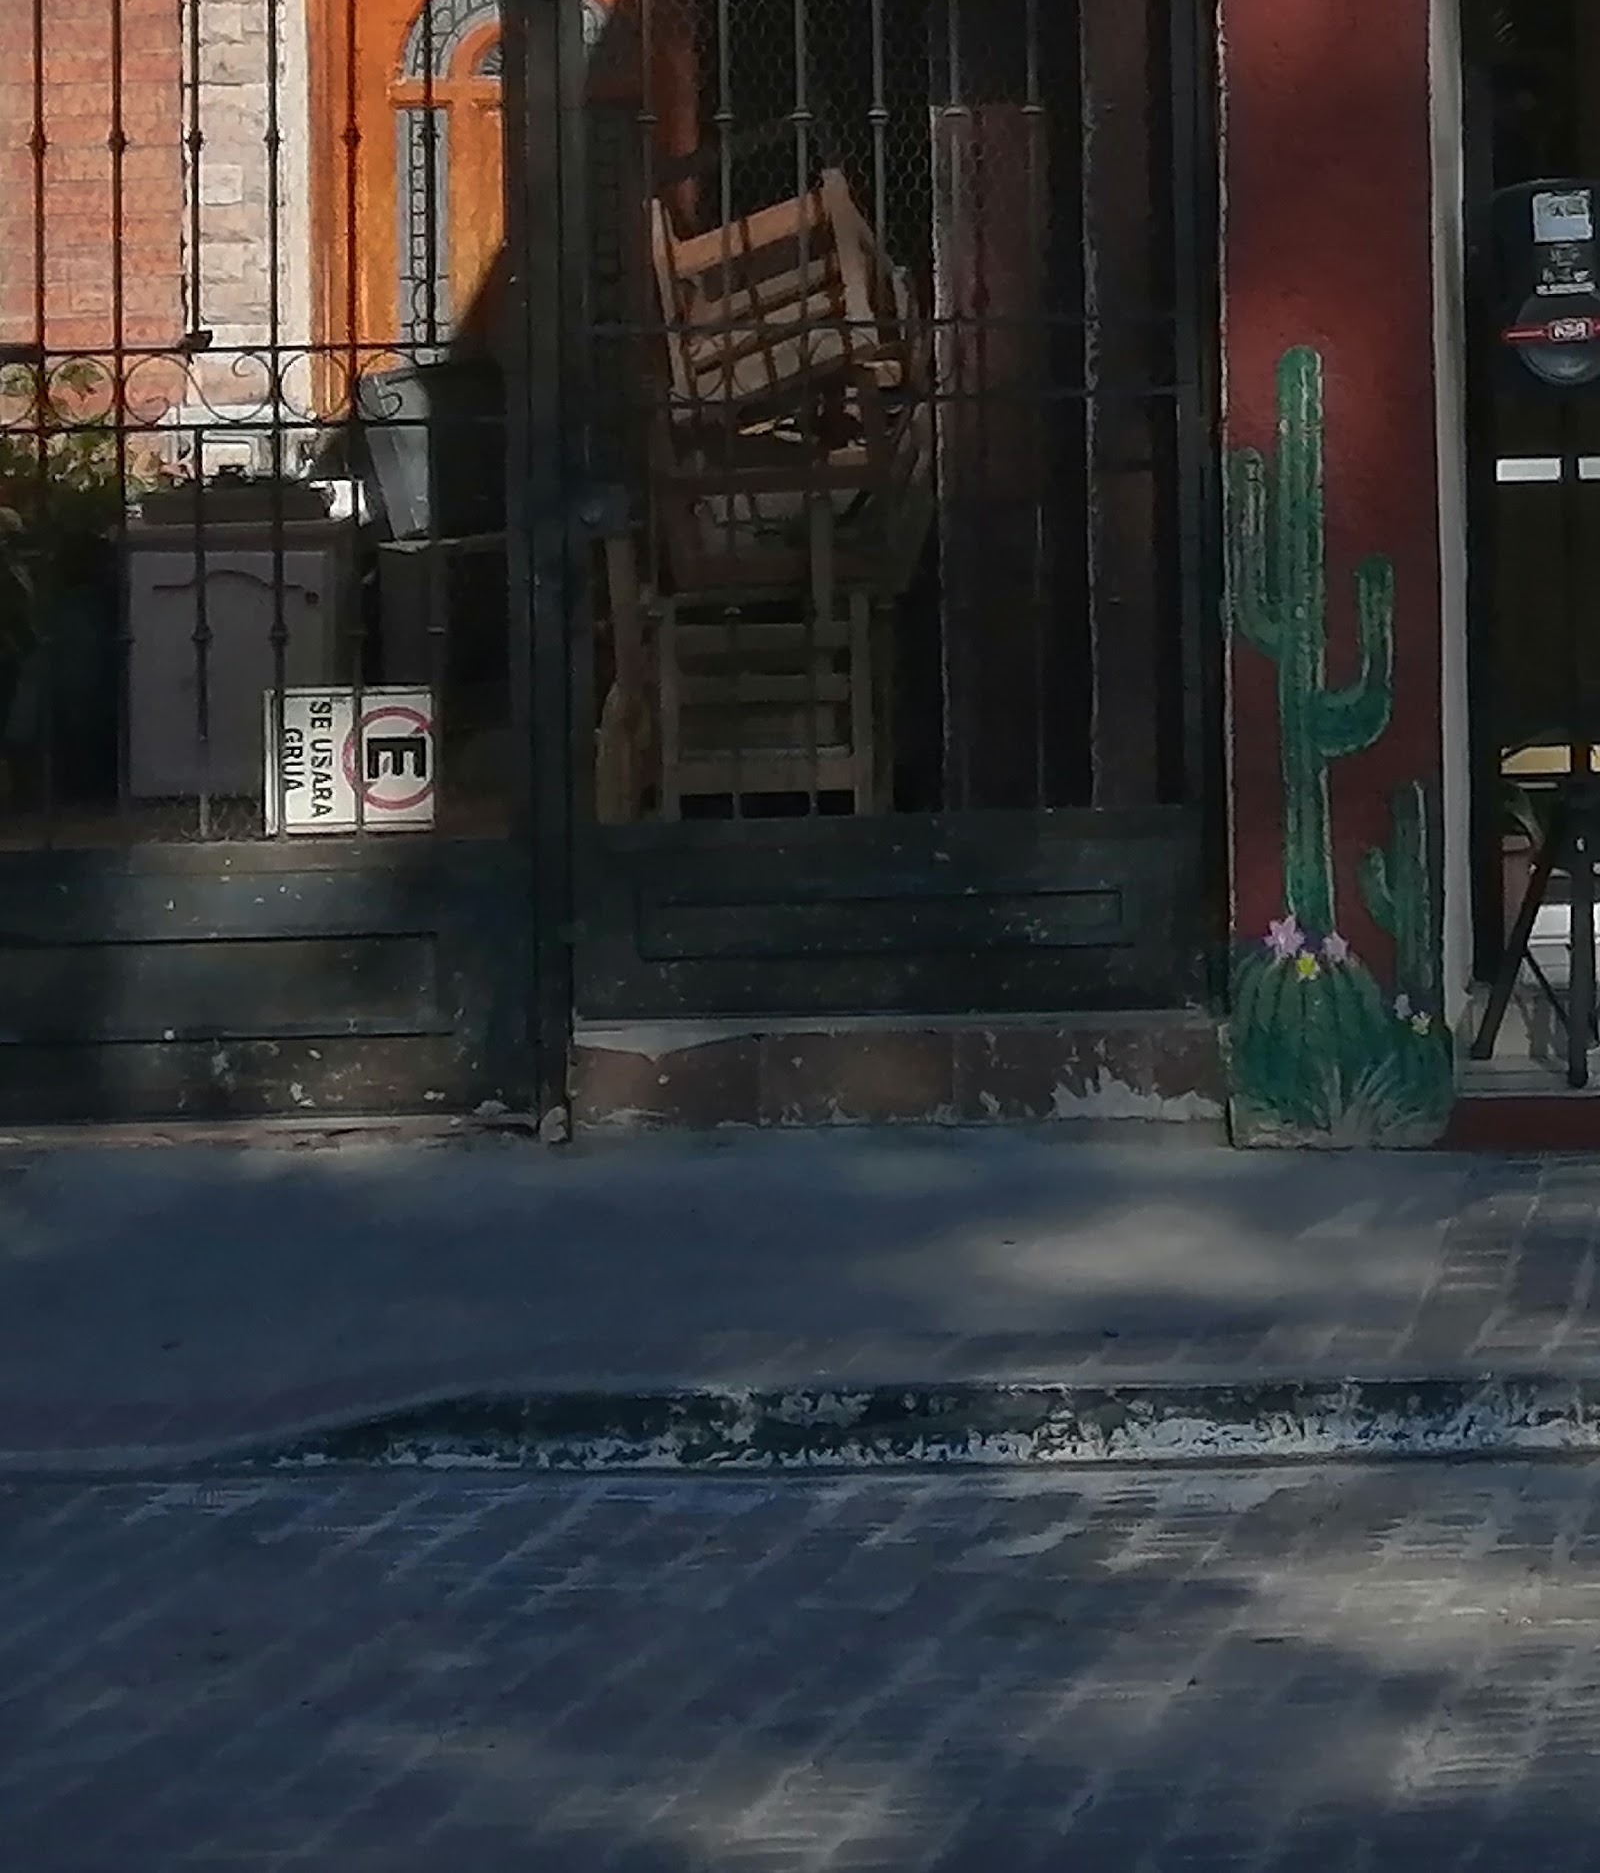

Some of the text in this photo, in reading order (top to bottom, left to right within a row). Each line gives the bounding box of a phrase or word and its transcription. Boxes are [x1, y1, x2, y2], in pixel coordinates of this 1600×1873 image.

[282, 727, 304, 791] GRUA
[310, 700, 334, 818] SE USARA
